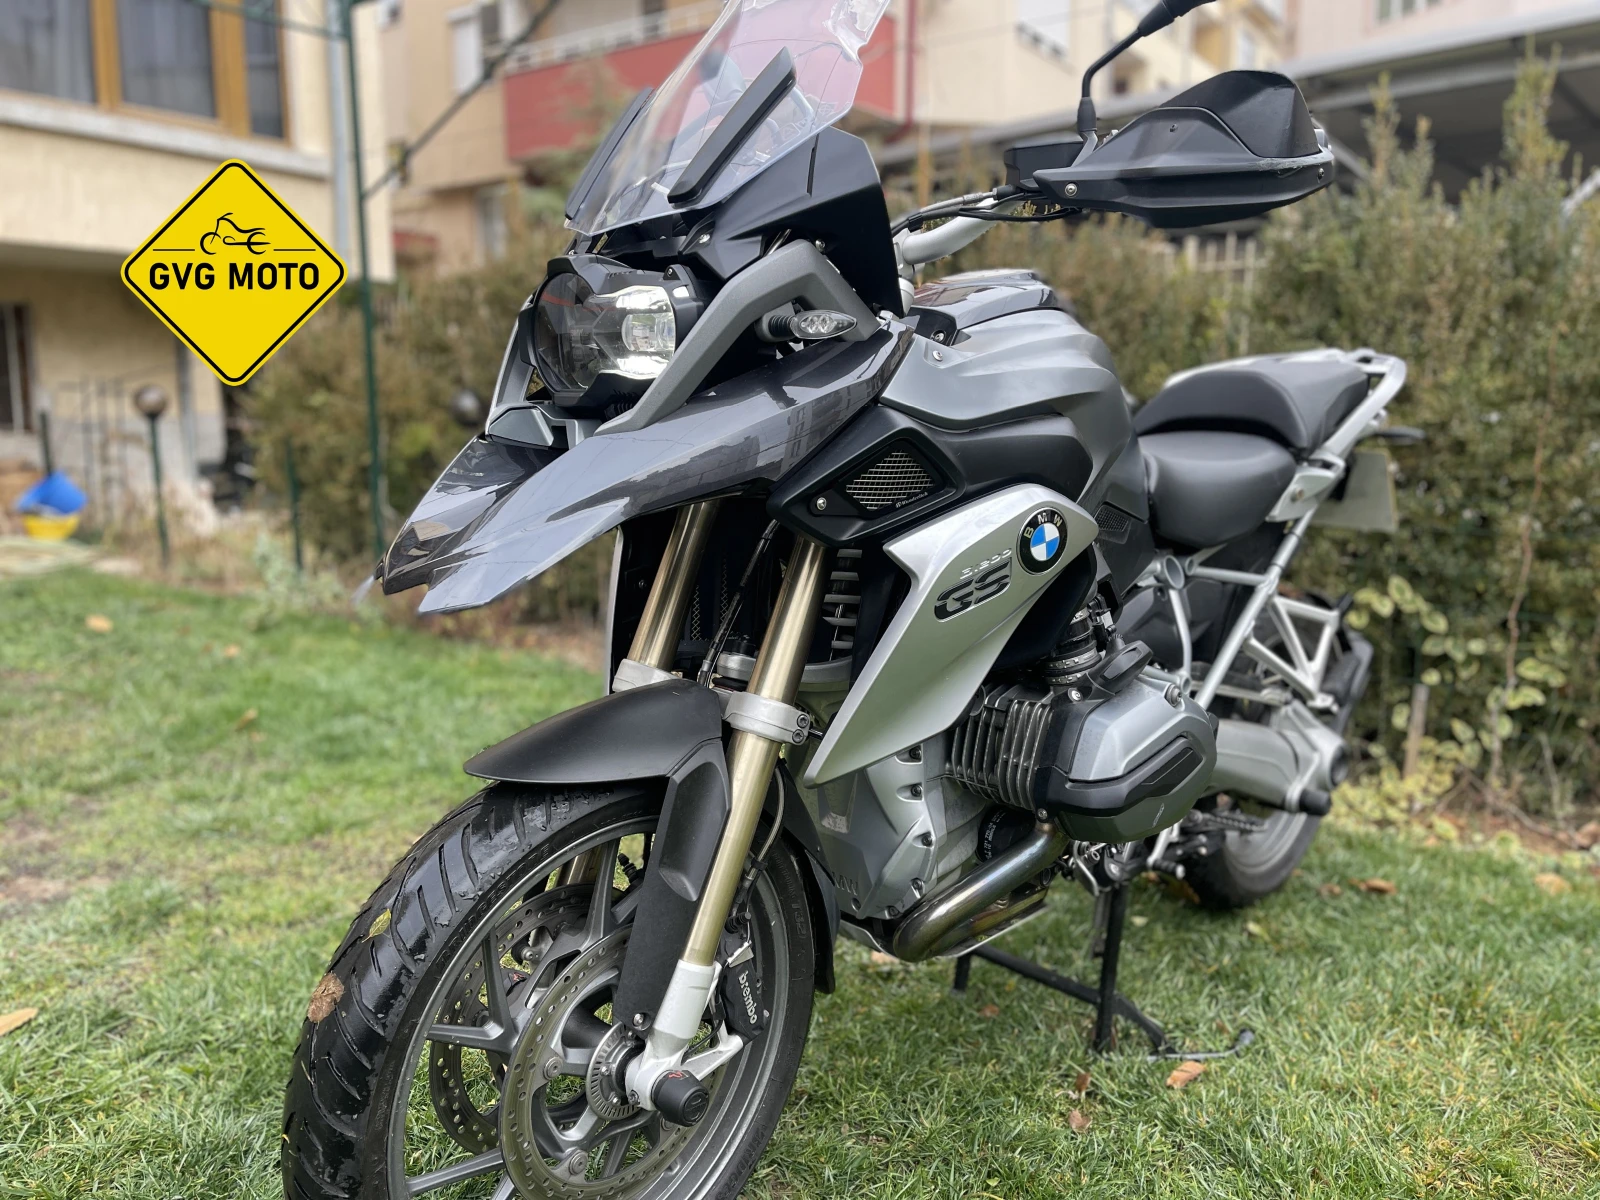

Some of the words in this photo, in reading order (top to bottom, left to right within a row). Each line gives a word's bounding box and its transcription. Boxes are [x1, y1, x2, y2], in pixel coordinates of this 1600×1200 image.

[1024, 512, 1063, 539] BMW
[934, 558, 1011, 622] GS
[739, 970, 758, 1024] brembo
